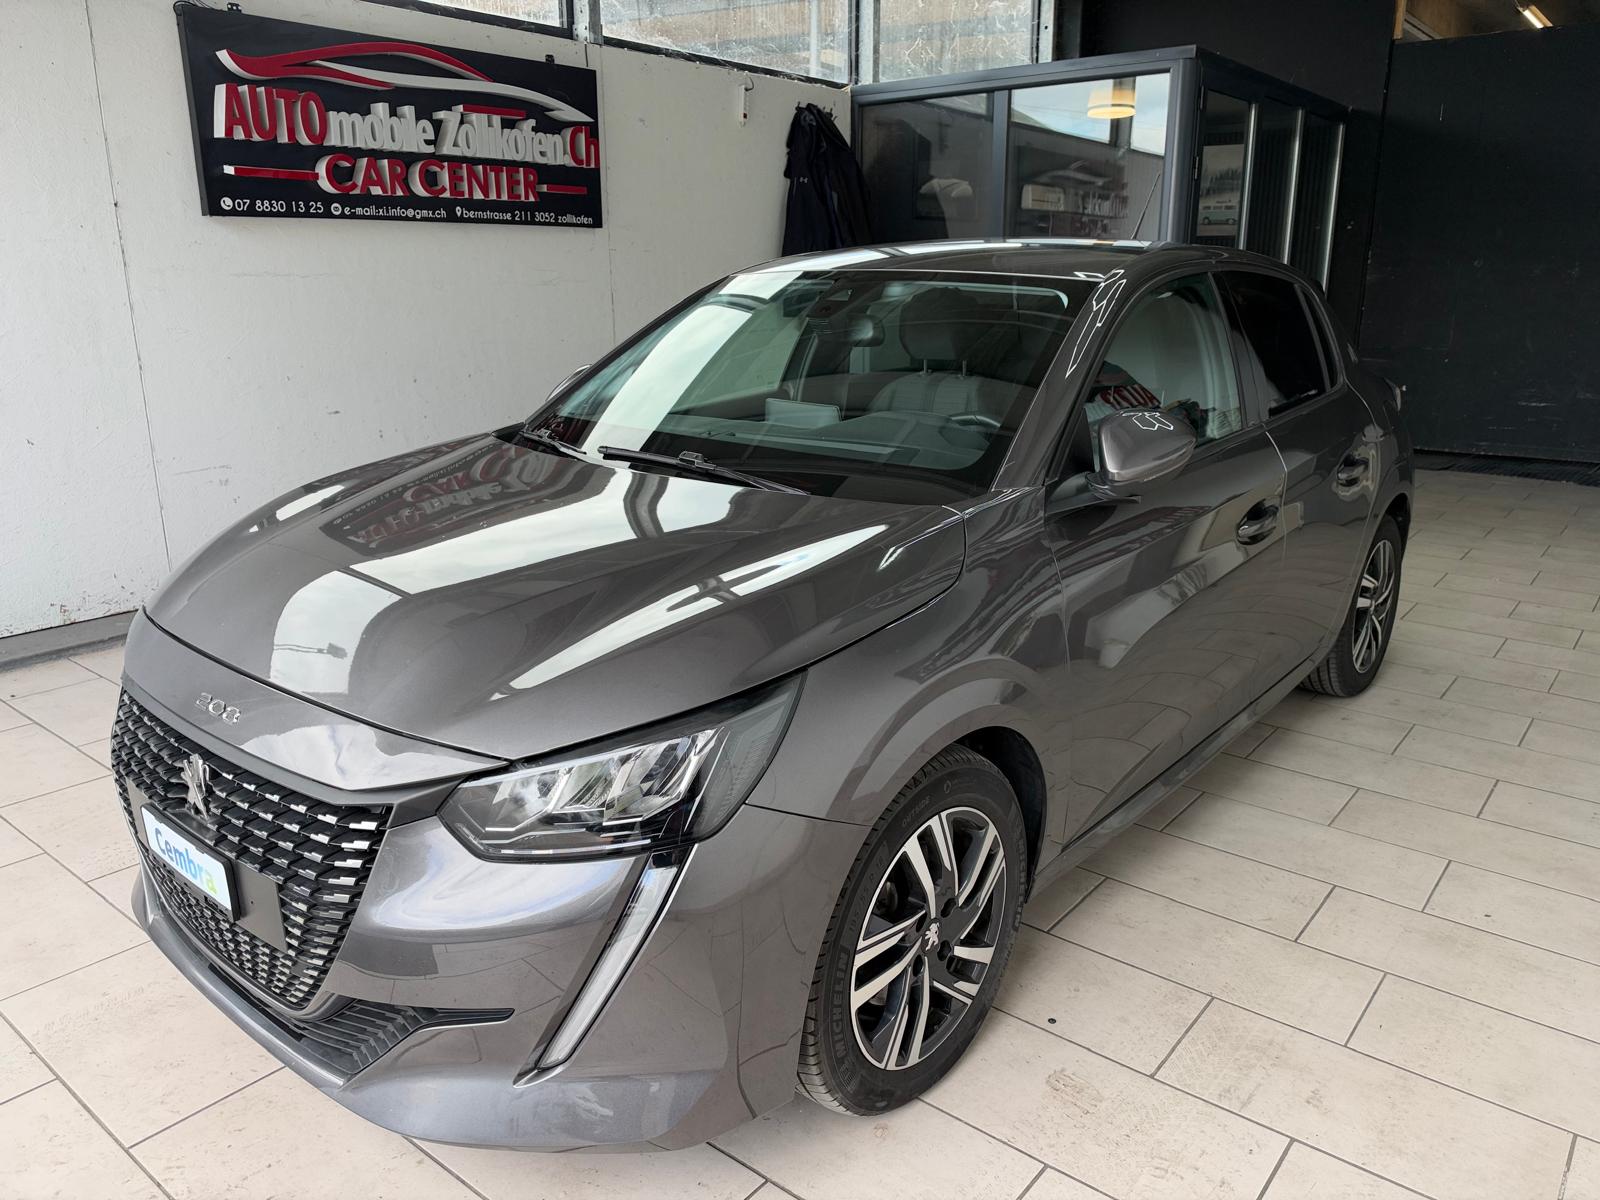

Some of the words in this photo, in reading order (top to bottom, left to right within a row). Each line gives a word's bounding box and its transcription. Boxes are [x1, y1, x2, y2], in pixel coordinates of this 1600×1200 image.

[315, 154, 409, 197] CAR
[407, 159, 540, 202] CENTER
[234, 199, 250, 211] 07
[255, 199, 287, 212] 8830
[292, 201, 305, 213] 13
[309, 201, 324, 214] 25
[463, 207, 512, 220] bernstrasse
[514, 210, 531, 221] 211
[534, 211, 556, 223] 3052
[195, 692, 241, 725] 208
[154, 827, 218, 895] Cembra
[832, 950, 849, 1058] MICHELIN
